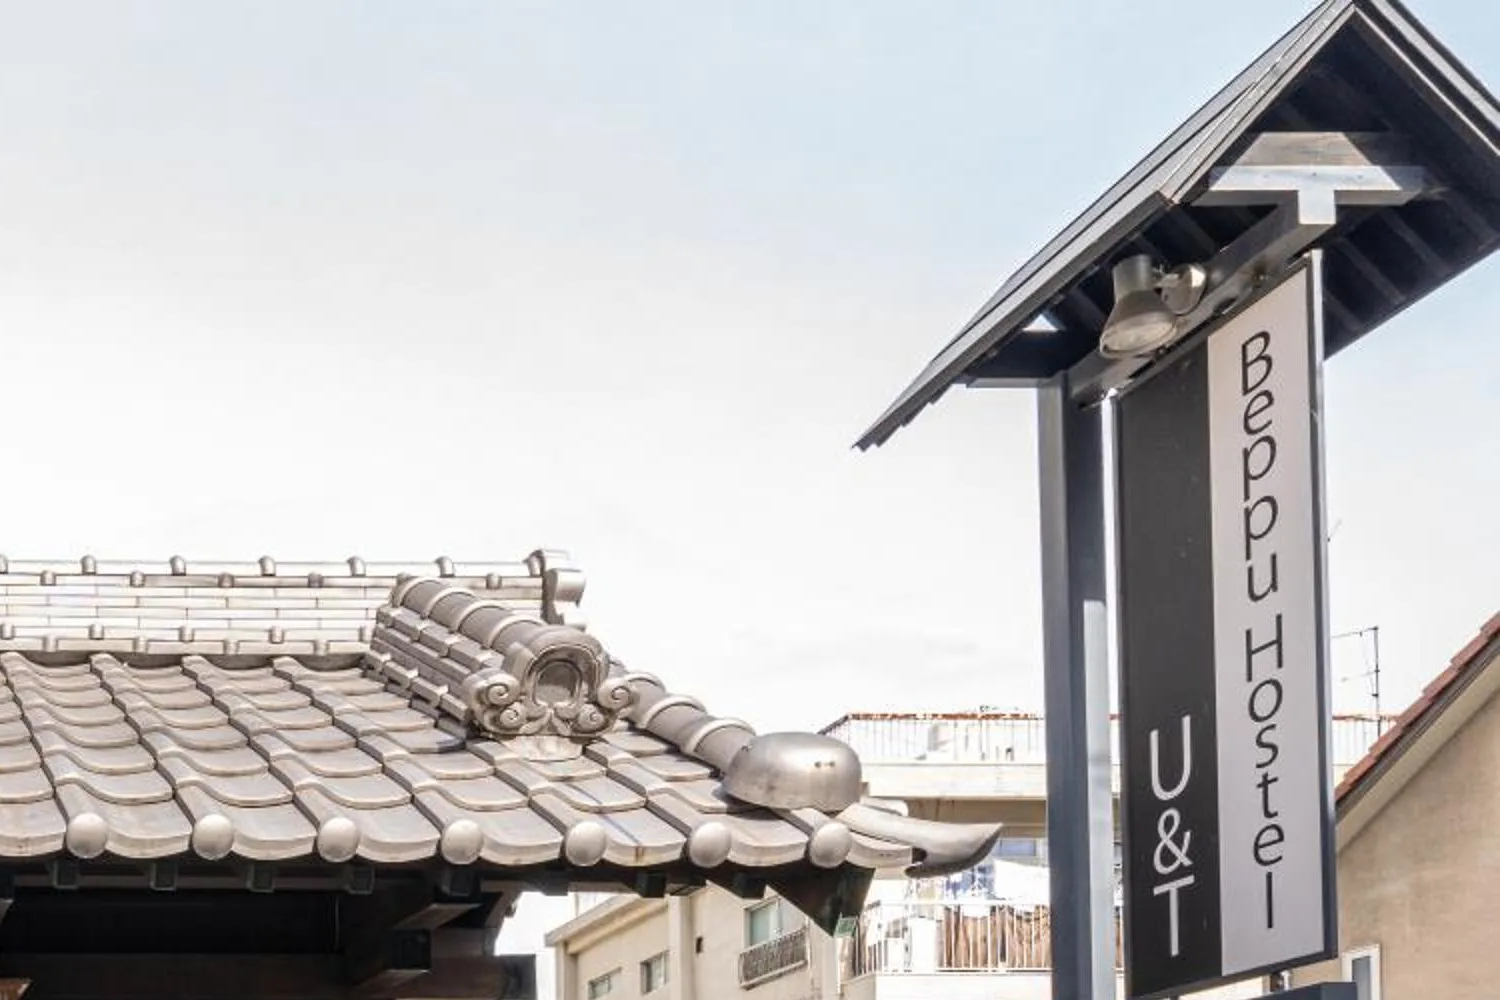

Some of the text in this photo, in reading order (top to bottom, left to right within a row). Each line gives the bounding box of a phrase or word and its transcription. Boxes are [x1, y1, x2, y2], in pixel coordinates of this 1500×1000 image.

[1149, 714, 1195, 957] U&T
[1240, 330, 1285, 929] Beppu Hostel
